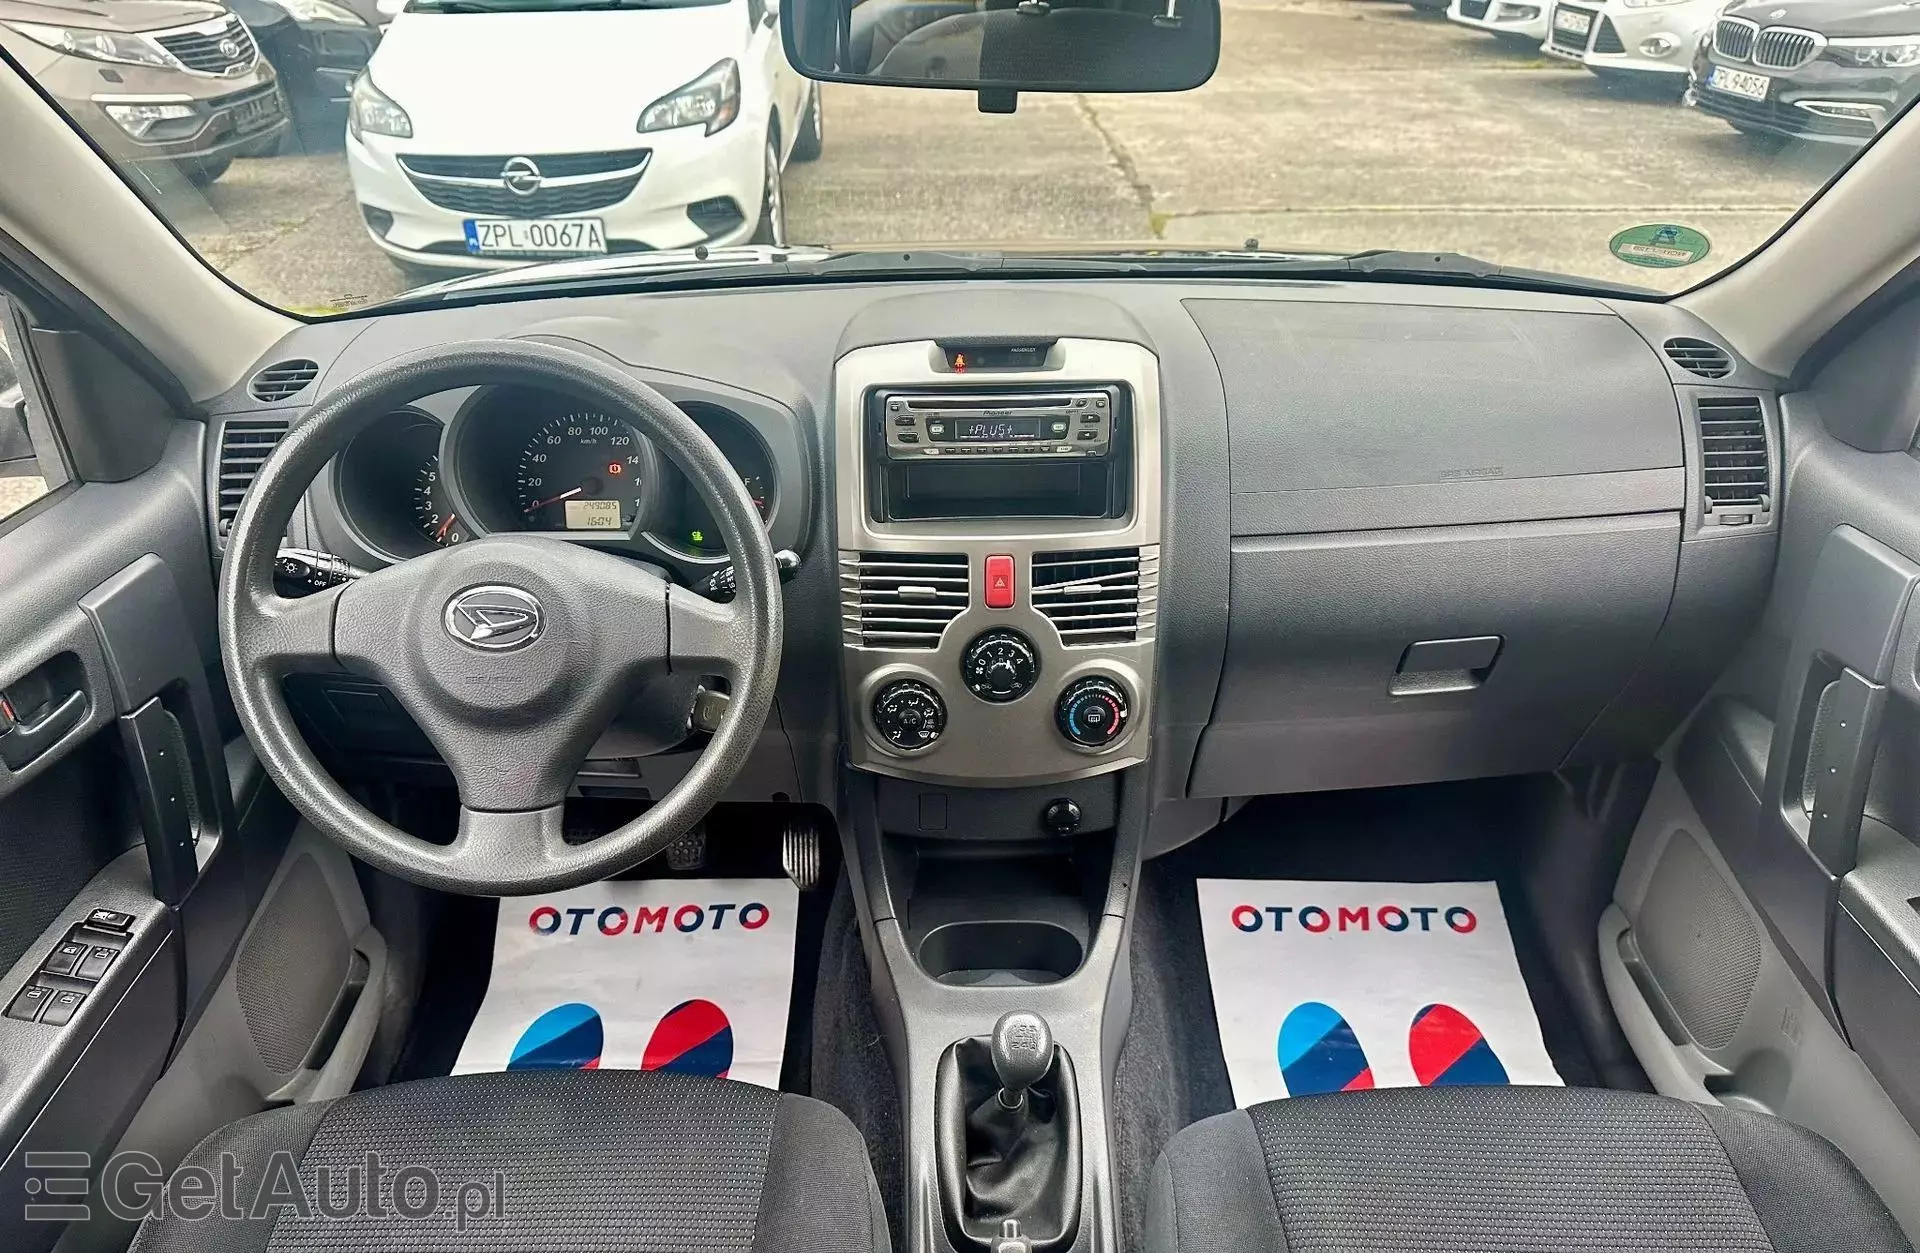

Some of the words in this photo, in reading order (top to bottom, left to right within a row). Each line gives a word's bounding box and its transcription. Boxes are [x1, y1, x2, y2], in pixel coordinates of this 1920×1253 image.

[478, 224, 524, 247] ZPL
[530, 223, 602, 248] 0067A
[568, 427, 582, 436] 80
[589, 426, 609, 436] 100
[547, 436, 561, 445] 60
[611, 436, 630, 446] 120
[532, 454, 547, 463] 40
[627, 455, 639, 465] 14
[428, 472, 436, 481] 5
[528, 478, 542, 487] 20
[744, 477, 751, 486] F
[423, 486, 431, 495] 4
[425, 501, 432, 510] 3
[431, 514, 439, 524] 2
[451, 532, 459, 542] 0
[997, 647, 1004, 656] 2
[1008, 650, 1016, 658] 3
[903, 717, 917, 725] A/C
[528, 902, 770, 937] OTOMOTO
[1231, 904, 1478, 934] OTOMOTO
